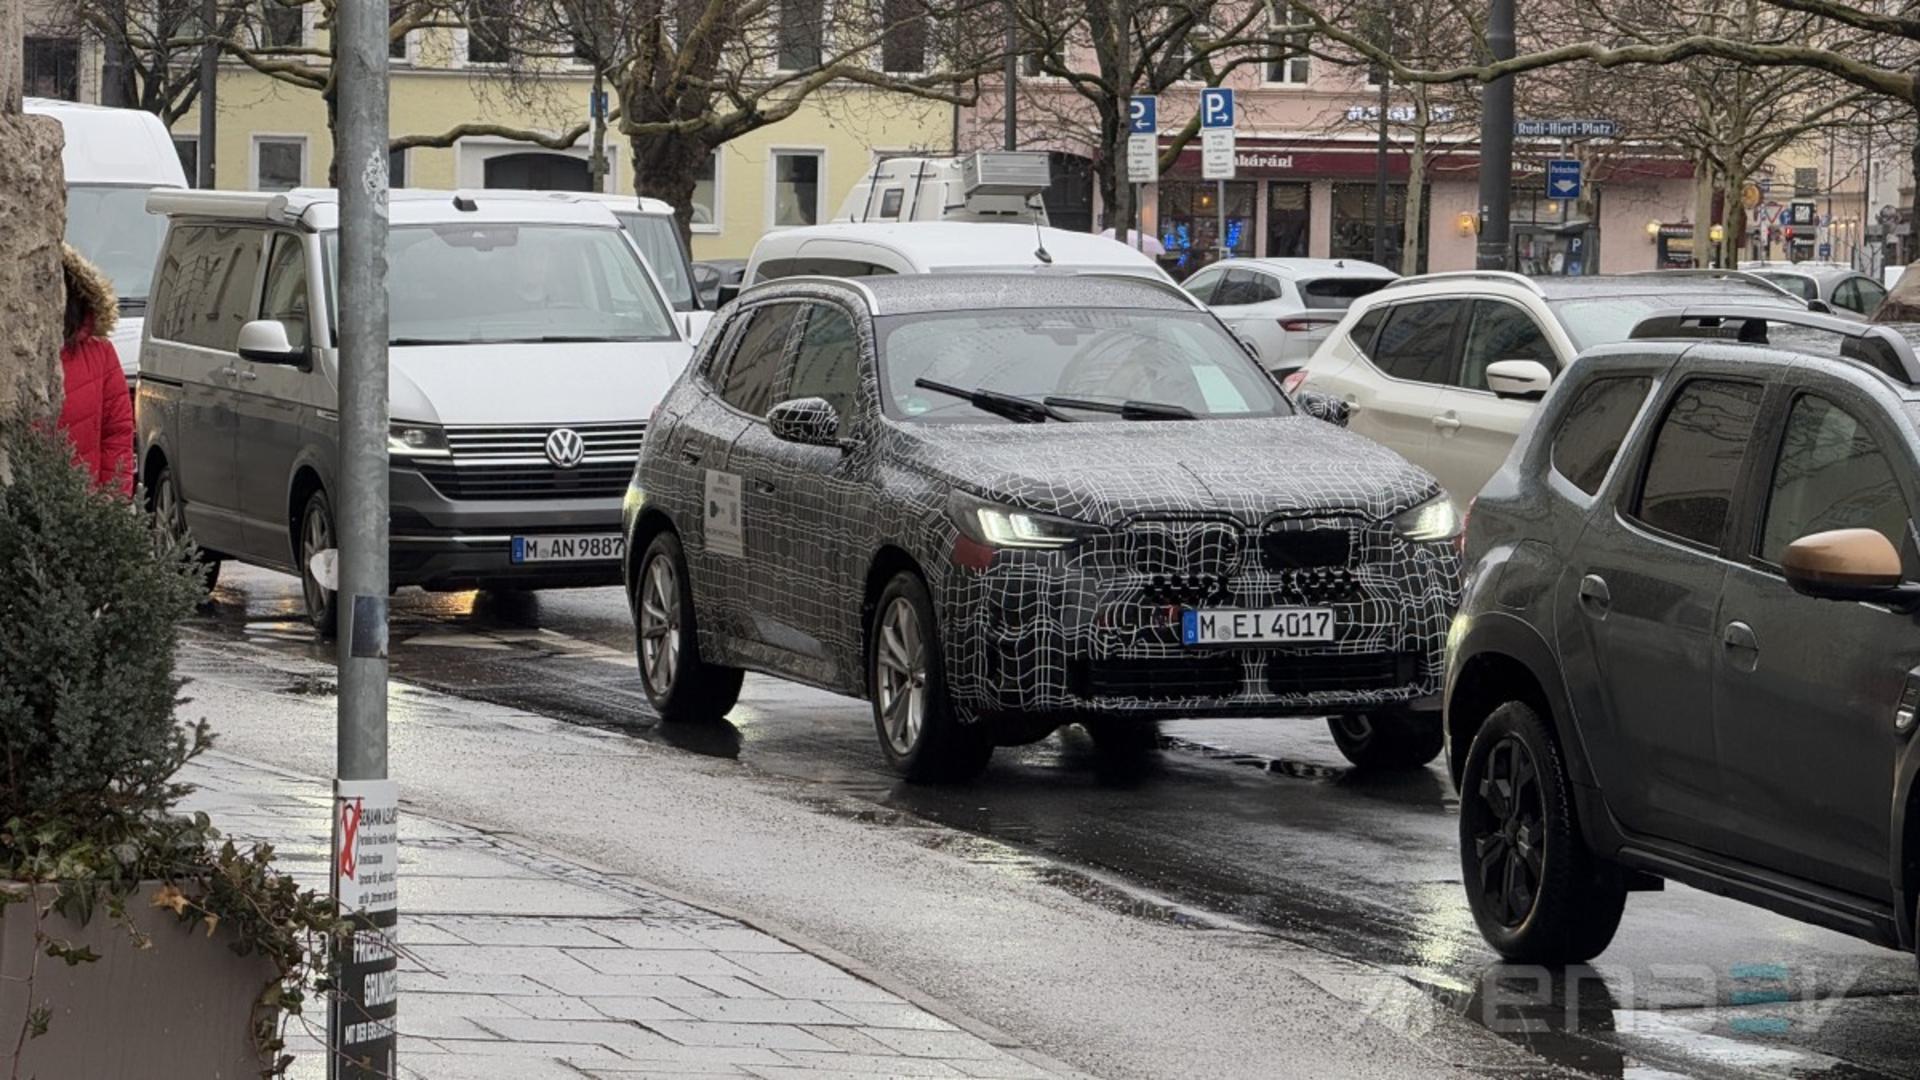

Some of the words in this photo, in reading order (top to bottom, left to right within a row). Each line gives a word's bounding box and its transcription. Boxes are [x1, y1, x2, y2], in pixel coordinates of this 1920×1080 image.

[1206, 93, 1224, 124] P
[1519, 122, 1610, 134] Rudi-Hierl-Platz
[1572, 238, 1581, 252] P
[526, 540, 538, 558] M
[551, 539, 574, 557] AN
[579, 537, 623, 557] 9887
[1200, 614, 1215, 639] M
[1233, 613, 1264, 638] EI
[1271, 612, 1330, 637] 4017
